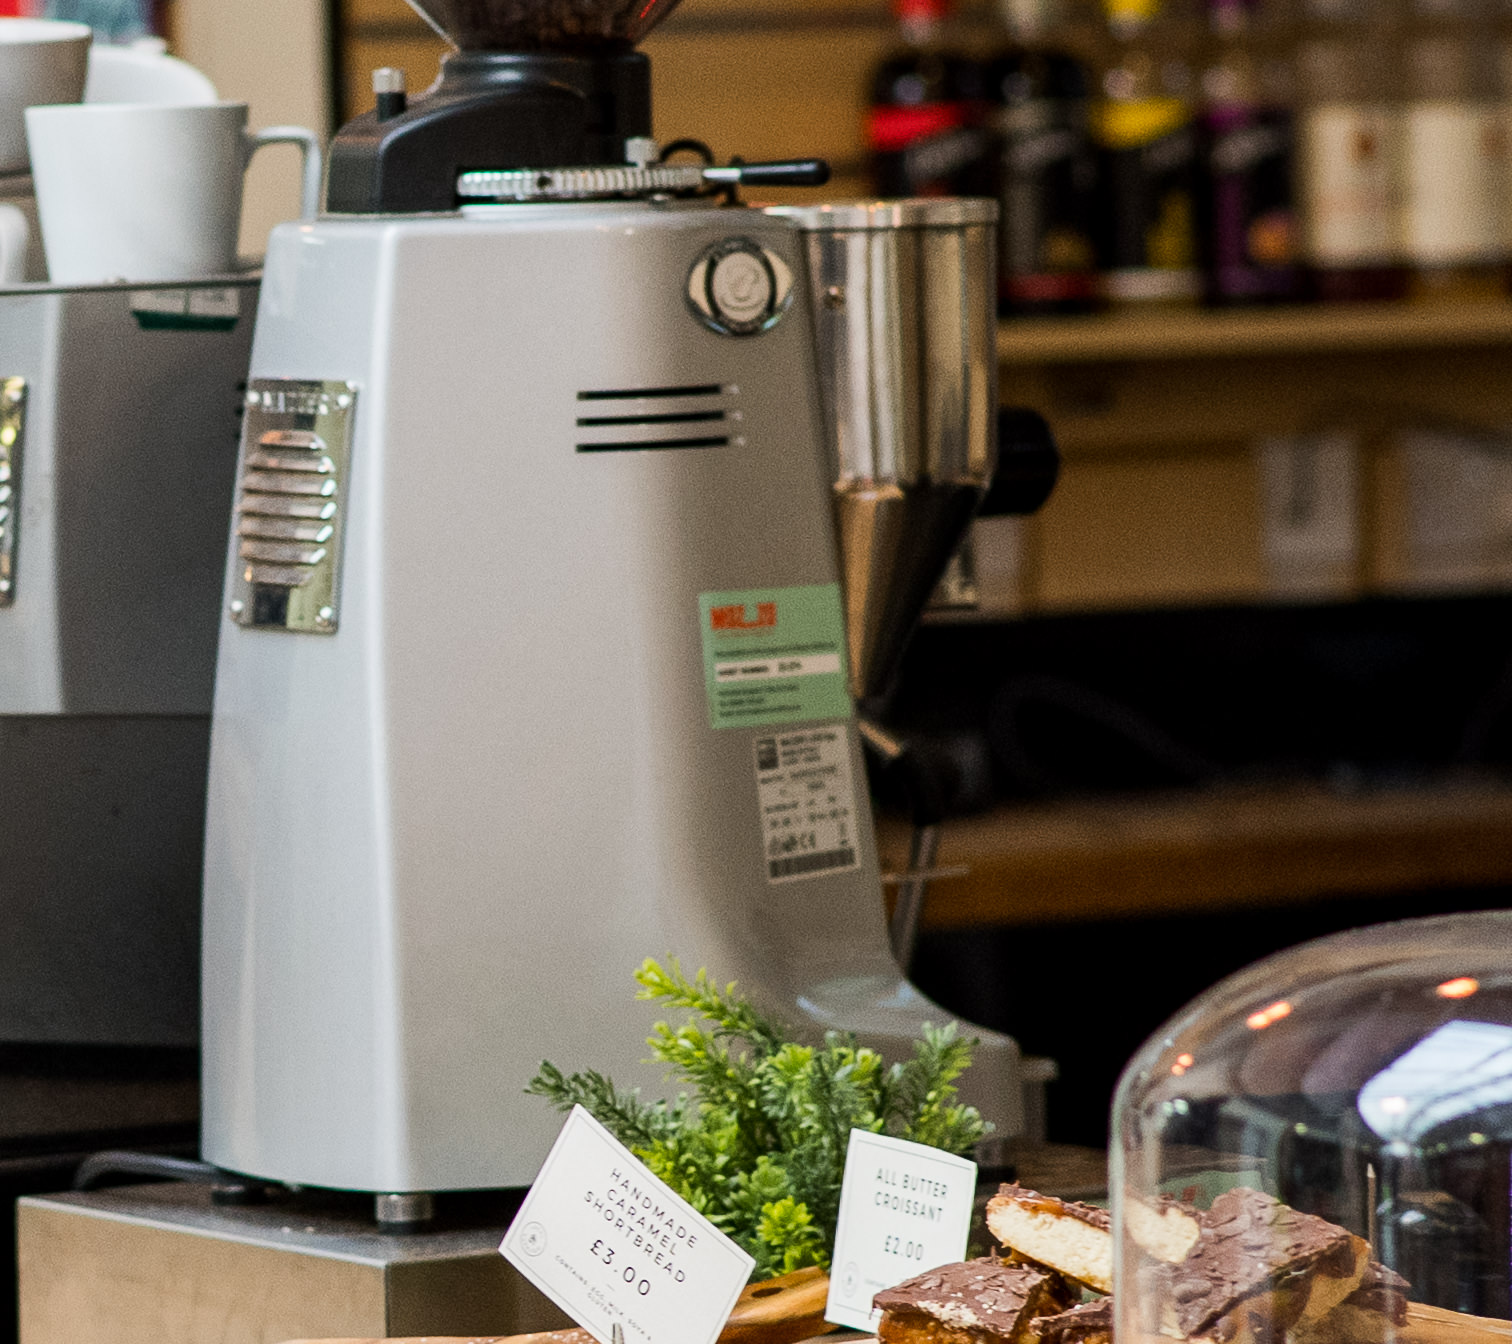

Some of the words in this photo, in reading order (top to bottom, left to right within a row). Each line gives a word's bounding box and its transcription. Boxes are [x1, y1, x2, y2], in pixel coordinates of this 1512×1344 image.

[610, 1167, 698, 1249] HANDMADE
[875, 1191, 943, 1223] CROISSANT
[876, 1167, 897, 1186] ALL
[903, 1174, 948, 1199] BUTTER
[583, 1191, 687, 1283] SHORTBREAD
[607, 1189, 678, 1256] CARAMEL
[885, 1234, 924, 1261] £2.00
[590, 1239, 651, 1296] £3.00
